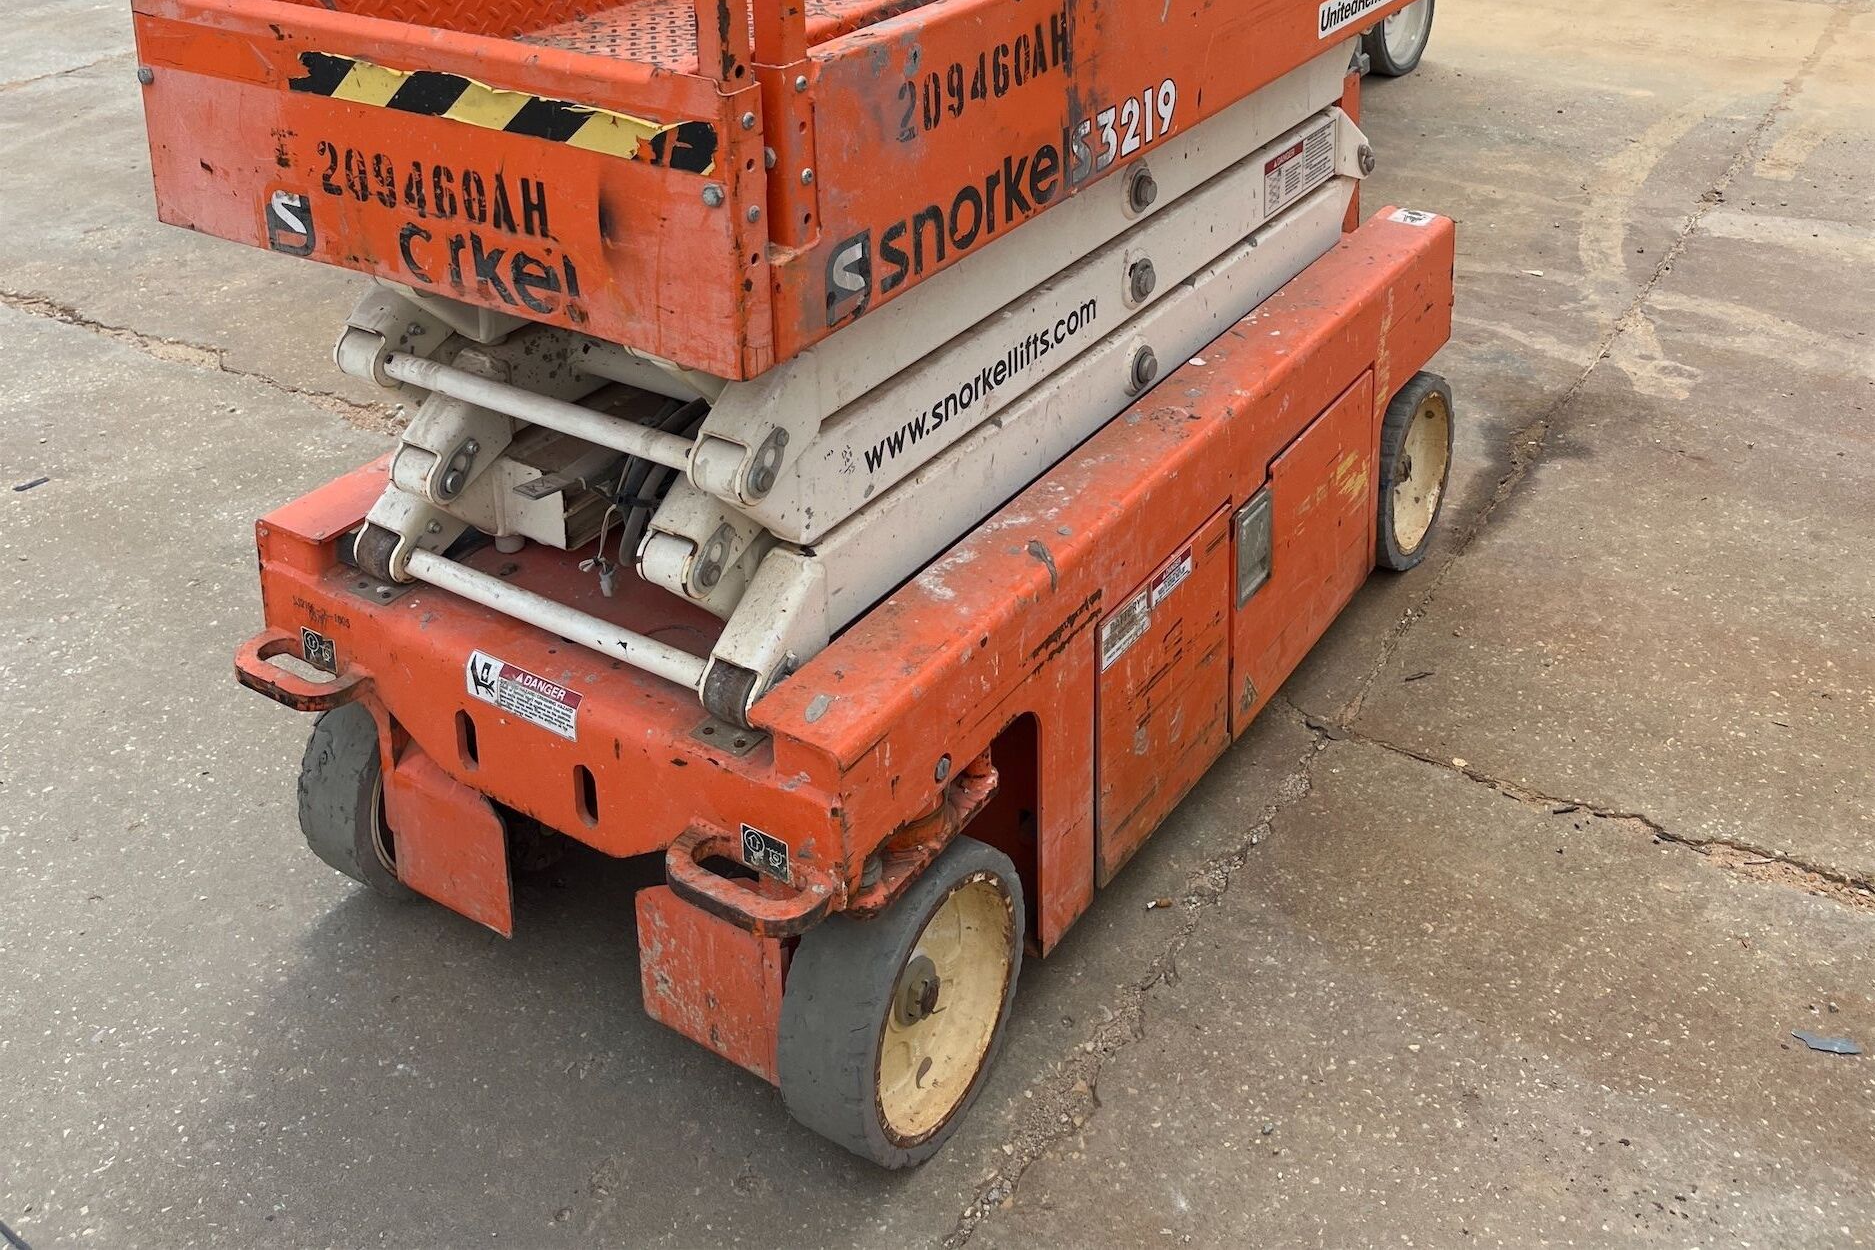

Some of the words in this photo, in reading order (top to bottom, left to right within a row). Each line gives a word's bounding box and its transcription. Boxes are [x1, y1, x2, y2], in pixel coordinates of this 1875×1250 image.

[897, 11, 1069, 143] 209460AH
[317, 140, 550, 238] 209460AH
[880, 127, 1070, 294] snorkel
[1072, 78, 1177, 184] S3219
[864, 298, 1098, 474] www.snorkellifts.com
[523, 672, 567, 702] DANGER
